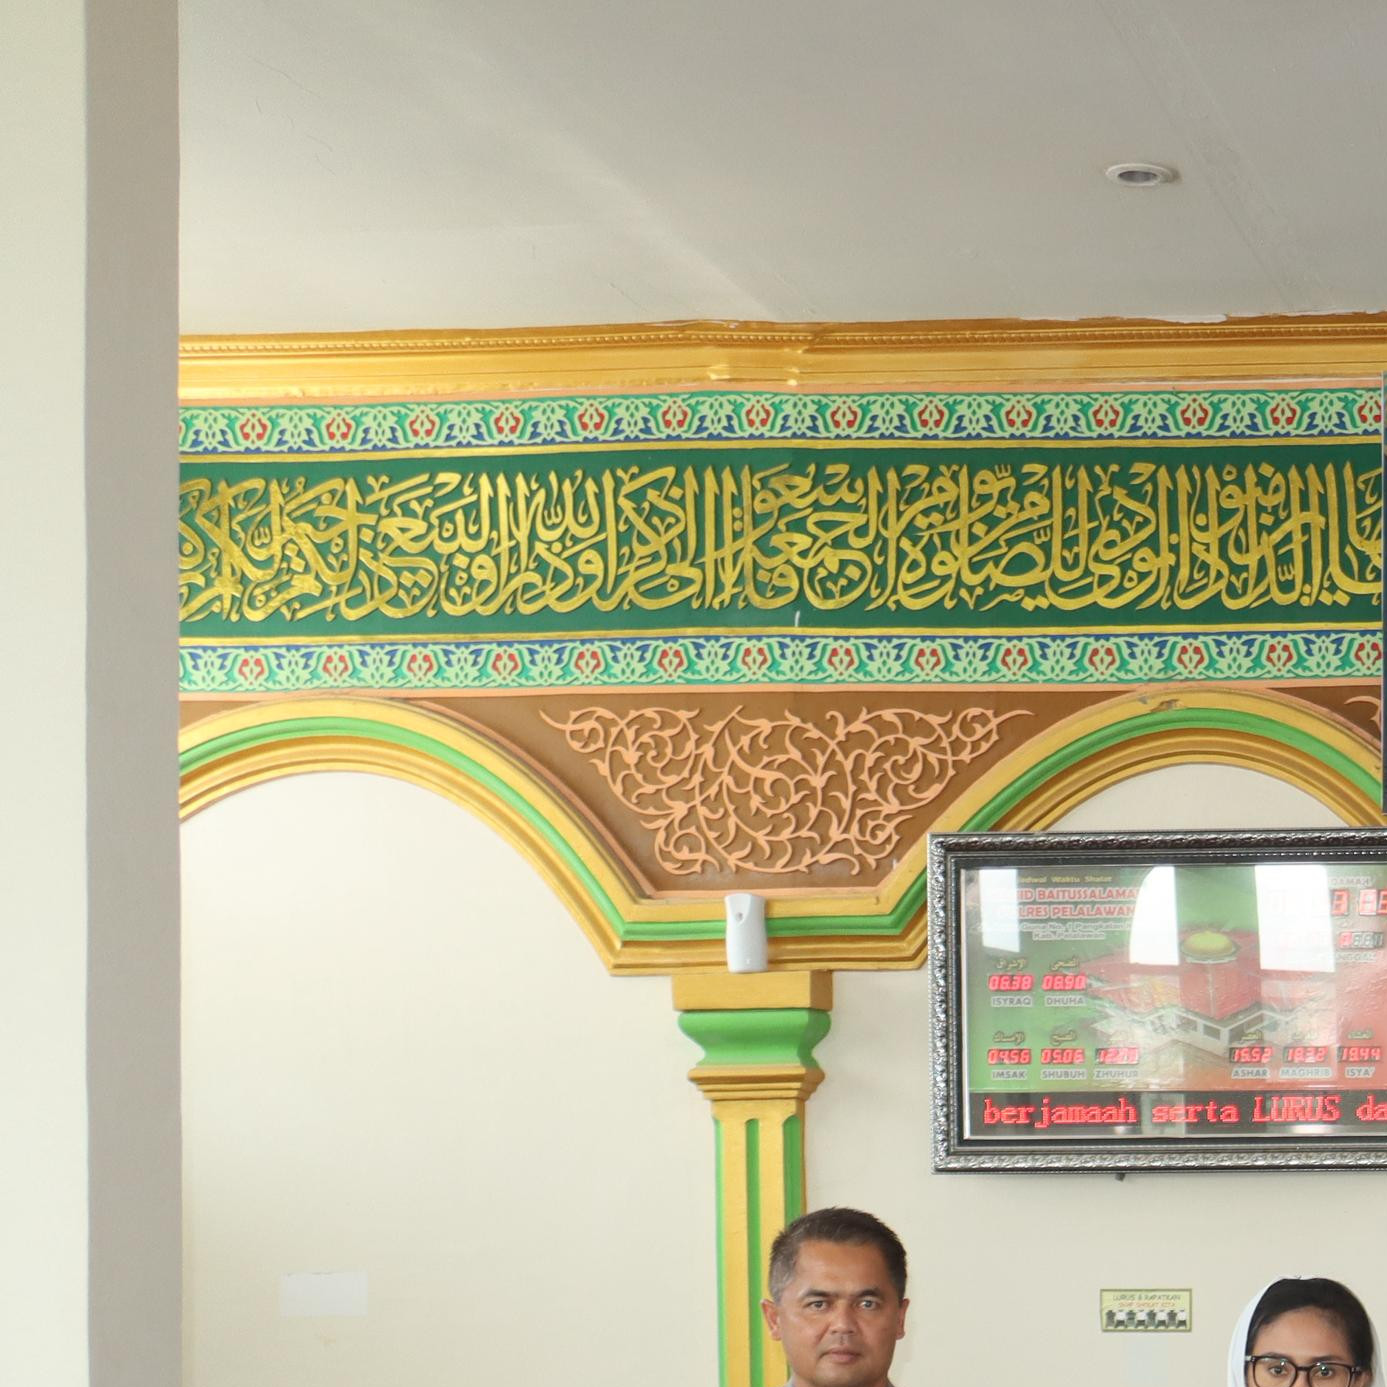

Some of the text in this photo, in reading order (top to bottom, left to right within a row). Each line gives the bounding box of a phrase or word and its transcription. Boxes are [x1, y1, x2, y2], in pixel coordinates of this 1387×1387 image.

[984, 1097, 1138, 1128] berjamaah
[1151, 1100, 1239, 1124] serta
[1252, 1095, 1341, 1123] LURUS
